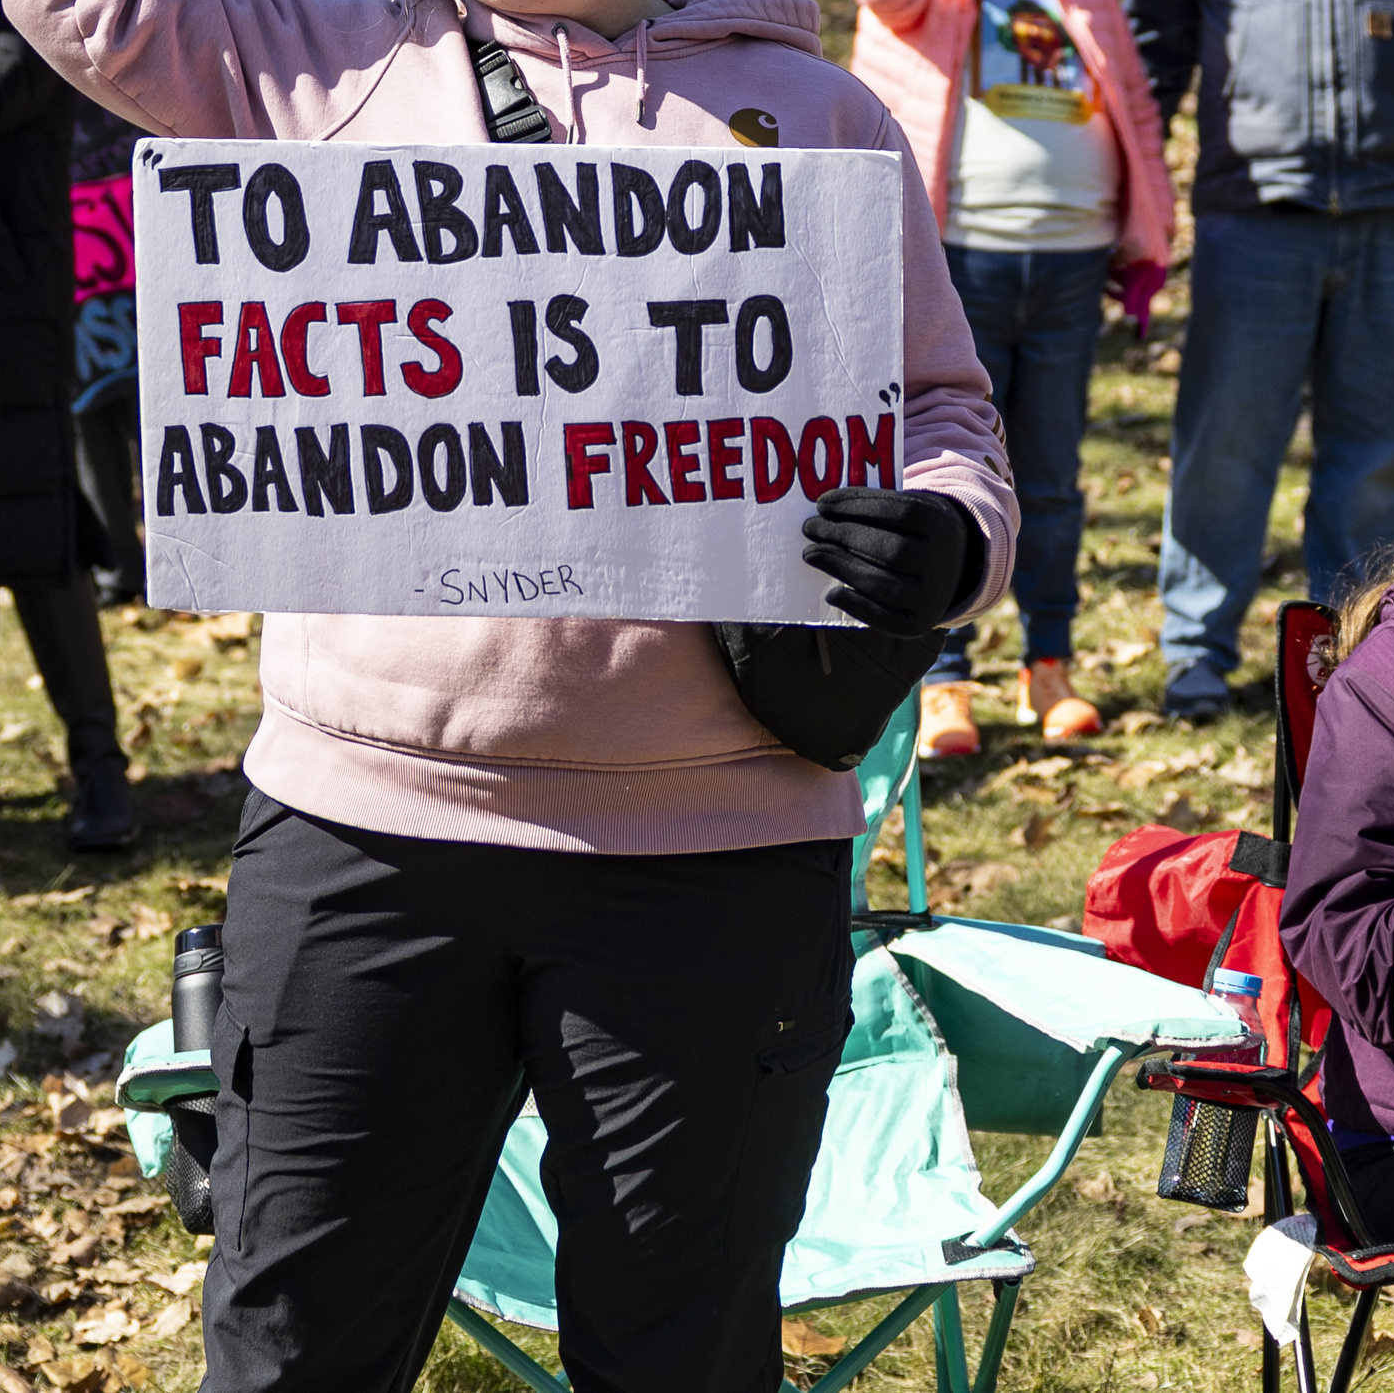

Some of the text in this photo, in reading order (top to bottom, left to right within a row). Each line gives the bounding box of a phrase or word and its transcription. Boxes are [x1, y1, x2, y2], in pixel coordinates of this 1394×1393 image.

[347, 158, 787, 266] ABANDON
[177, 296, 465, 399] FACTS
[507, 293, 600, 398] IS
[647, 293, 793, 396] TO
[156, 419, 530, 518] ABANDON
